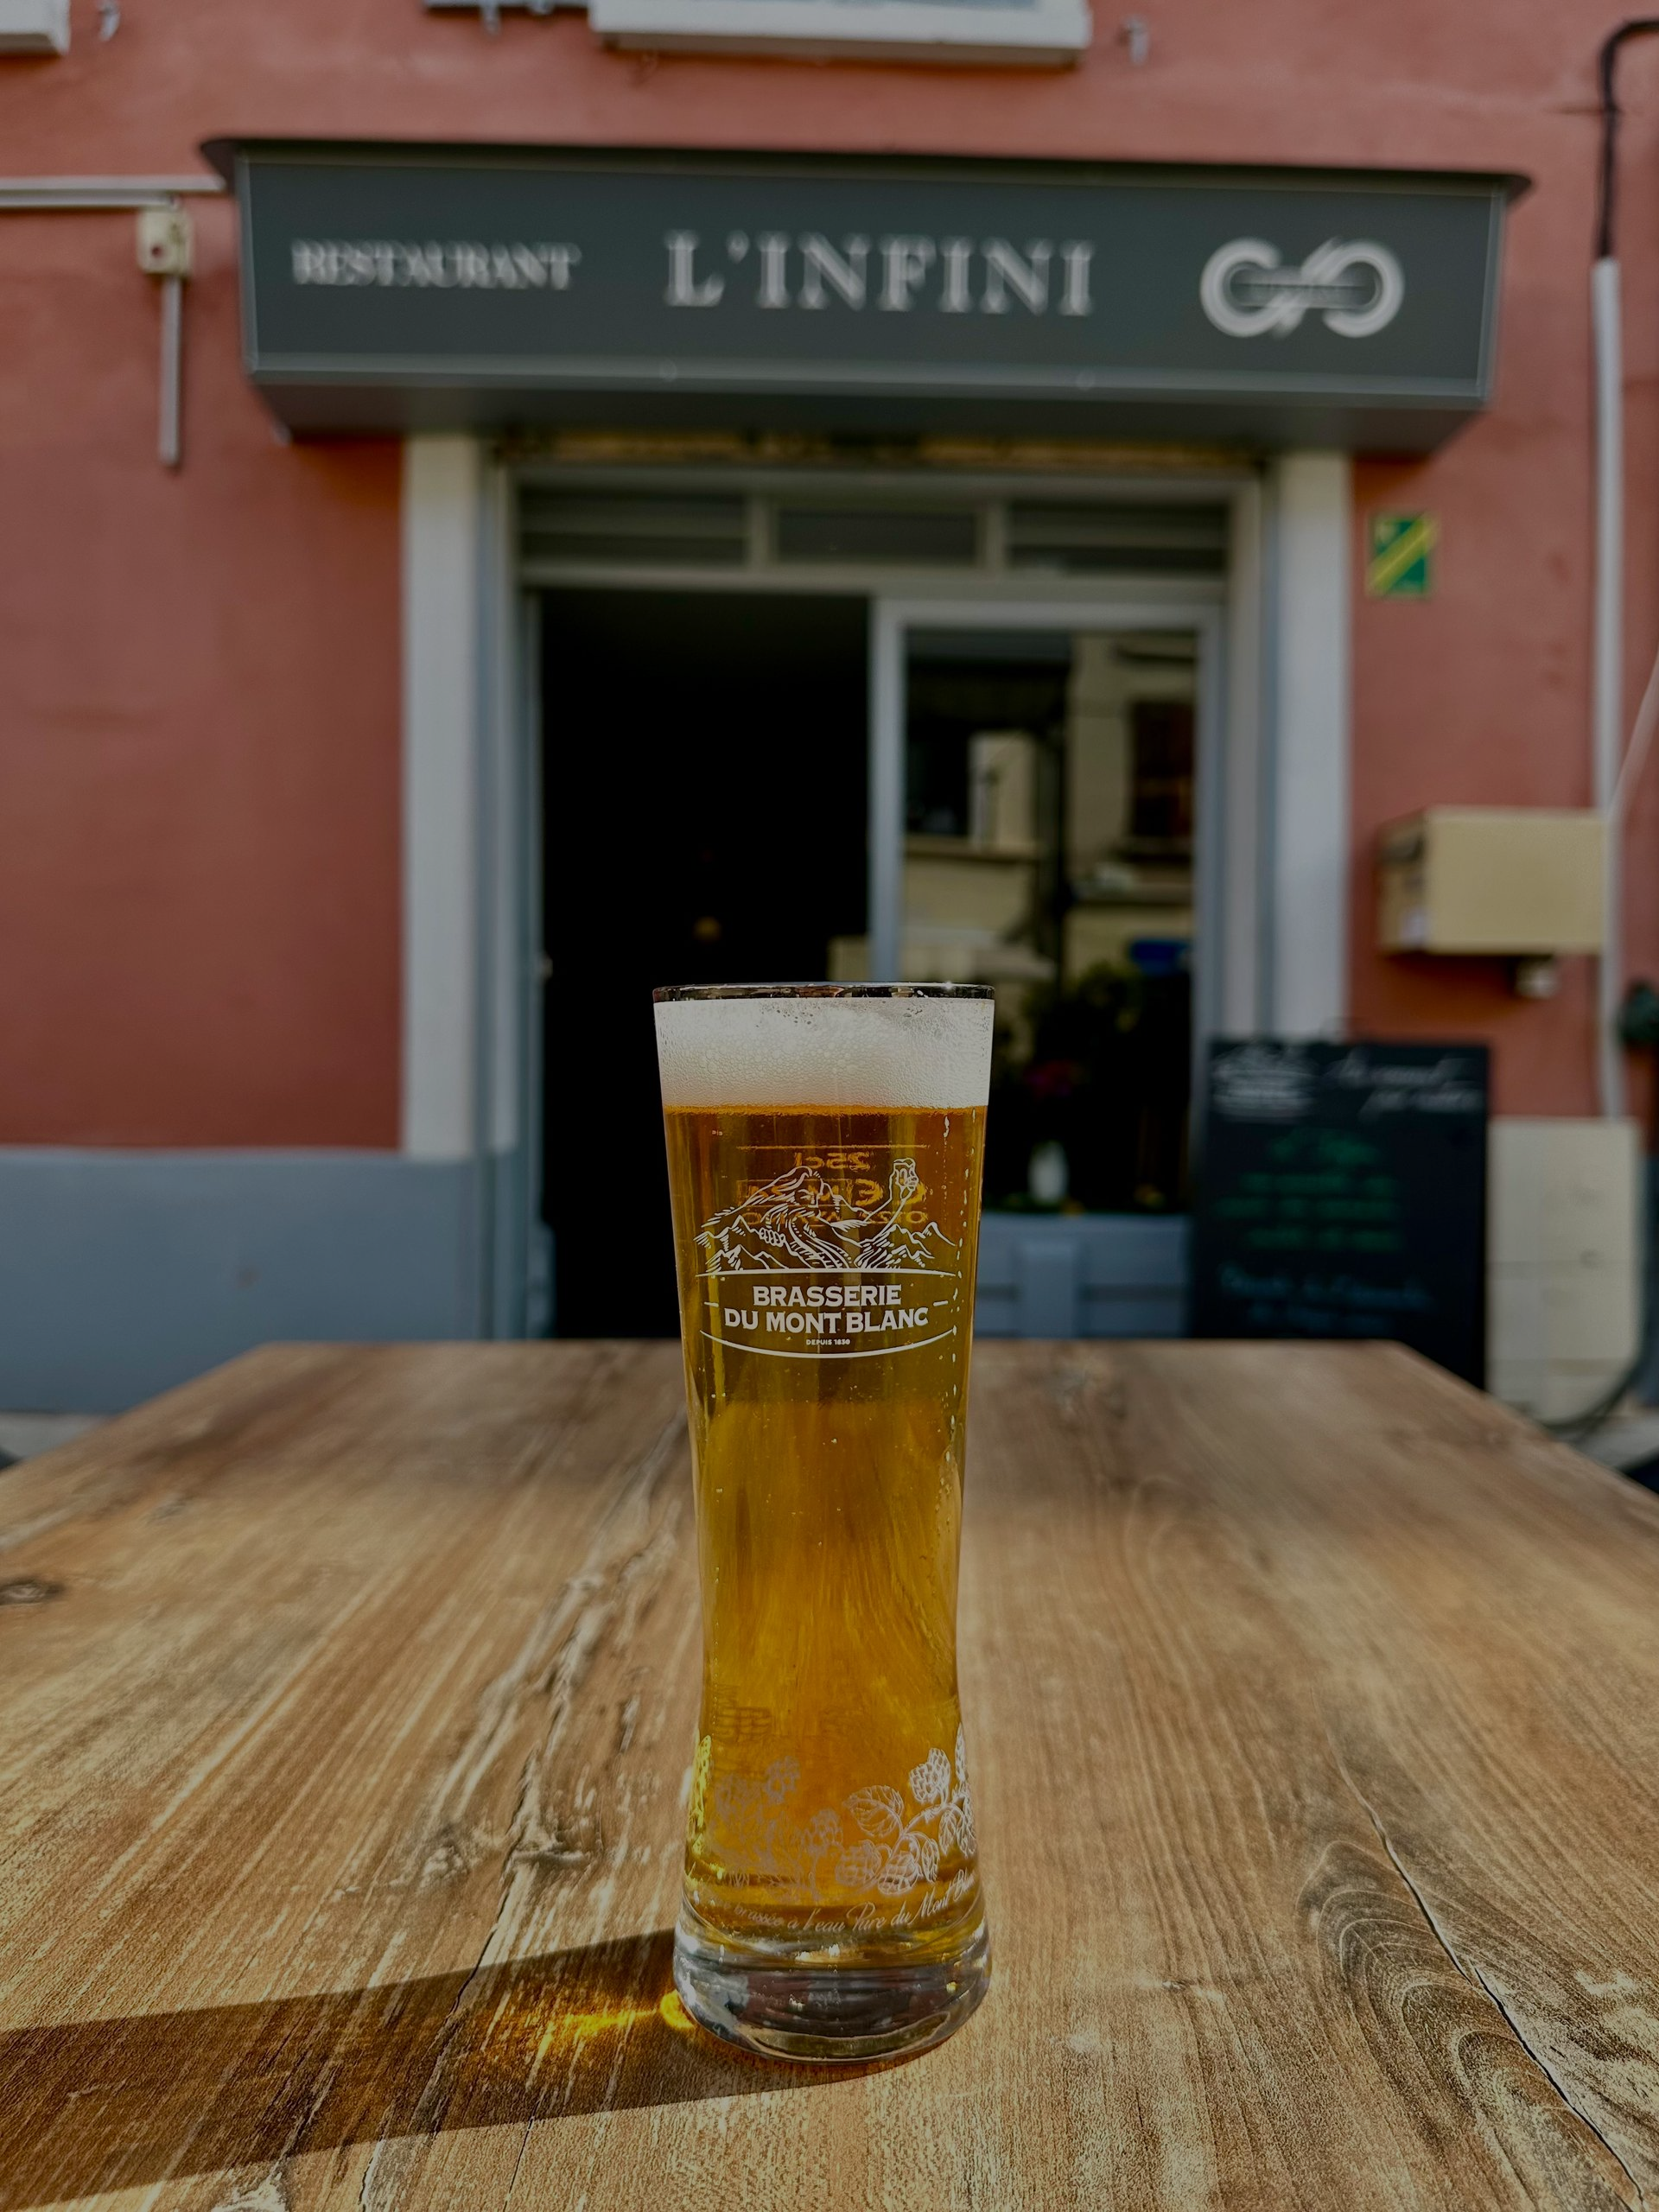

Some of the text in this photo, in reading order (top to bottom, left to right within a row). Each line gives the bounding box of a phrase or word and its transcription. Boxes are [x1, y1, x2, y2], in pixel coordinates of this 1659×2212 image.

[290, 230, 1096, 316] RESTAURANT L'INFINI
[753, 1284, 902, 1307] BRASSERIE
[724, 1307, 929, 1334] DU MONT BLANC
[890, 1901, 912, 1927] du
[907, 1879, 951, 1928] Mont
